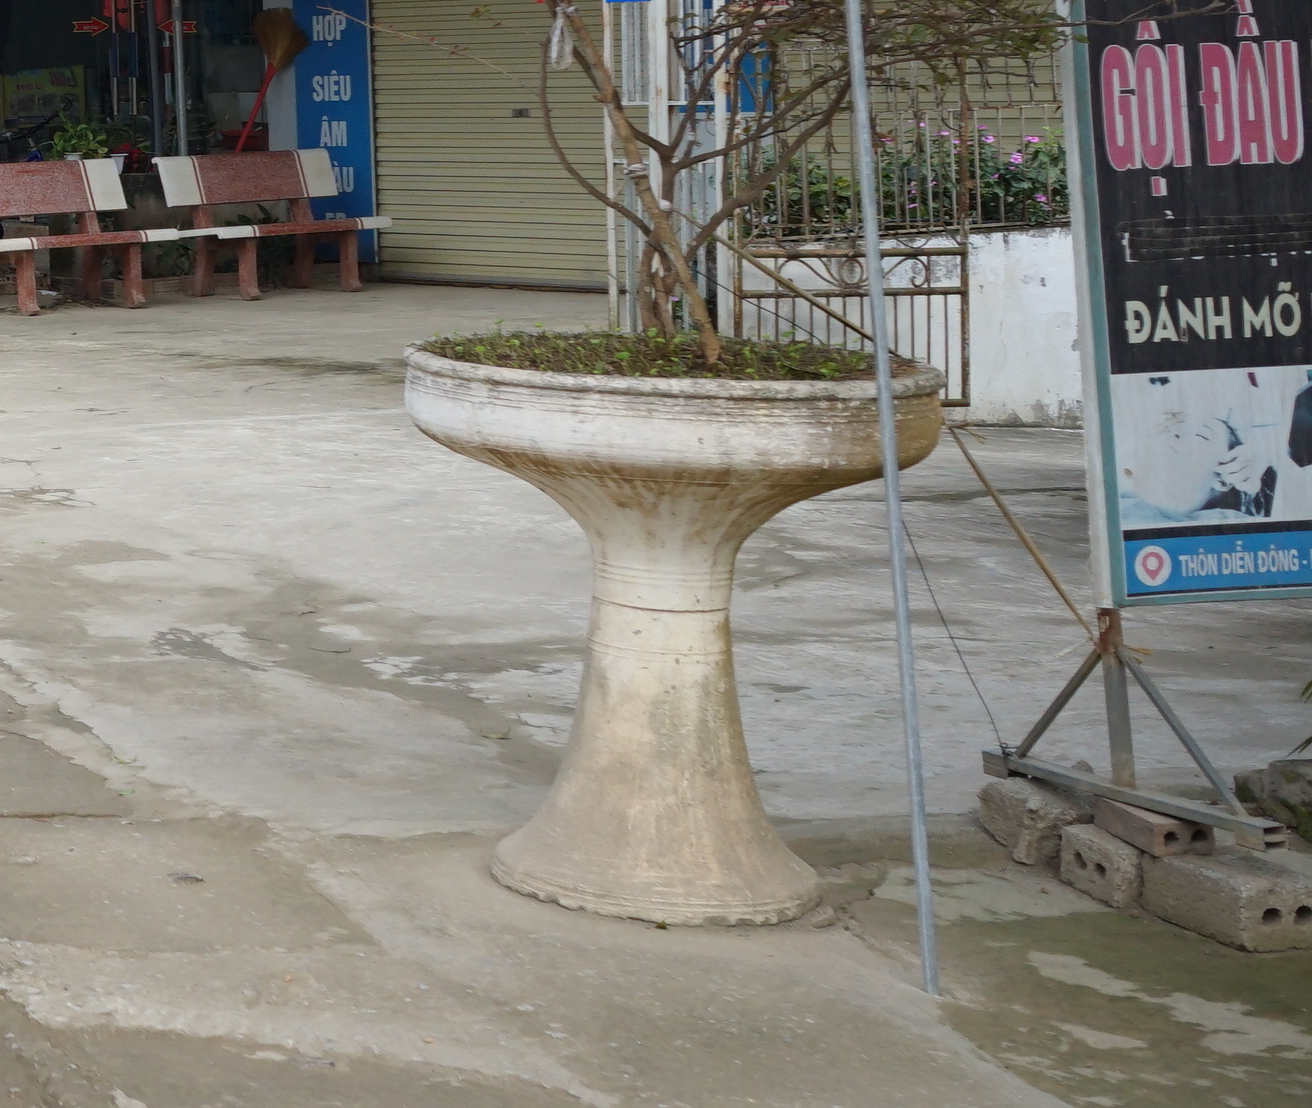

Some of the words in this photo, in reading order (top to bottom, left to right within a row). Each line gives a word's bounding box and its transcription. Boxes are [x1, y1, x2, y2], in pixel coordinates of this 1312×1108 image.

[312, 11, 346, 47] HỢP
[312, 70, 352, 103] SIÊU
[1100, 20, 1192, 196] GỘI
[319, 115, 347, 147] ÂM
[333, 160, 354, 193] ÀU
[1124, 285, 1232, 344] ĐÁNH
[1242, 281, 1302, 338] MỠ
[1178, 548, 1218, 577] THÔN
[1221, 540, 1255, 575] DIỄN
[1257, 544, 1300, 573] ĐÔNG
